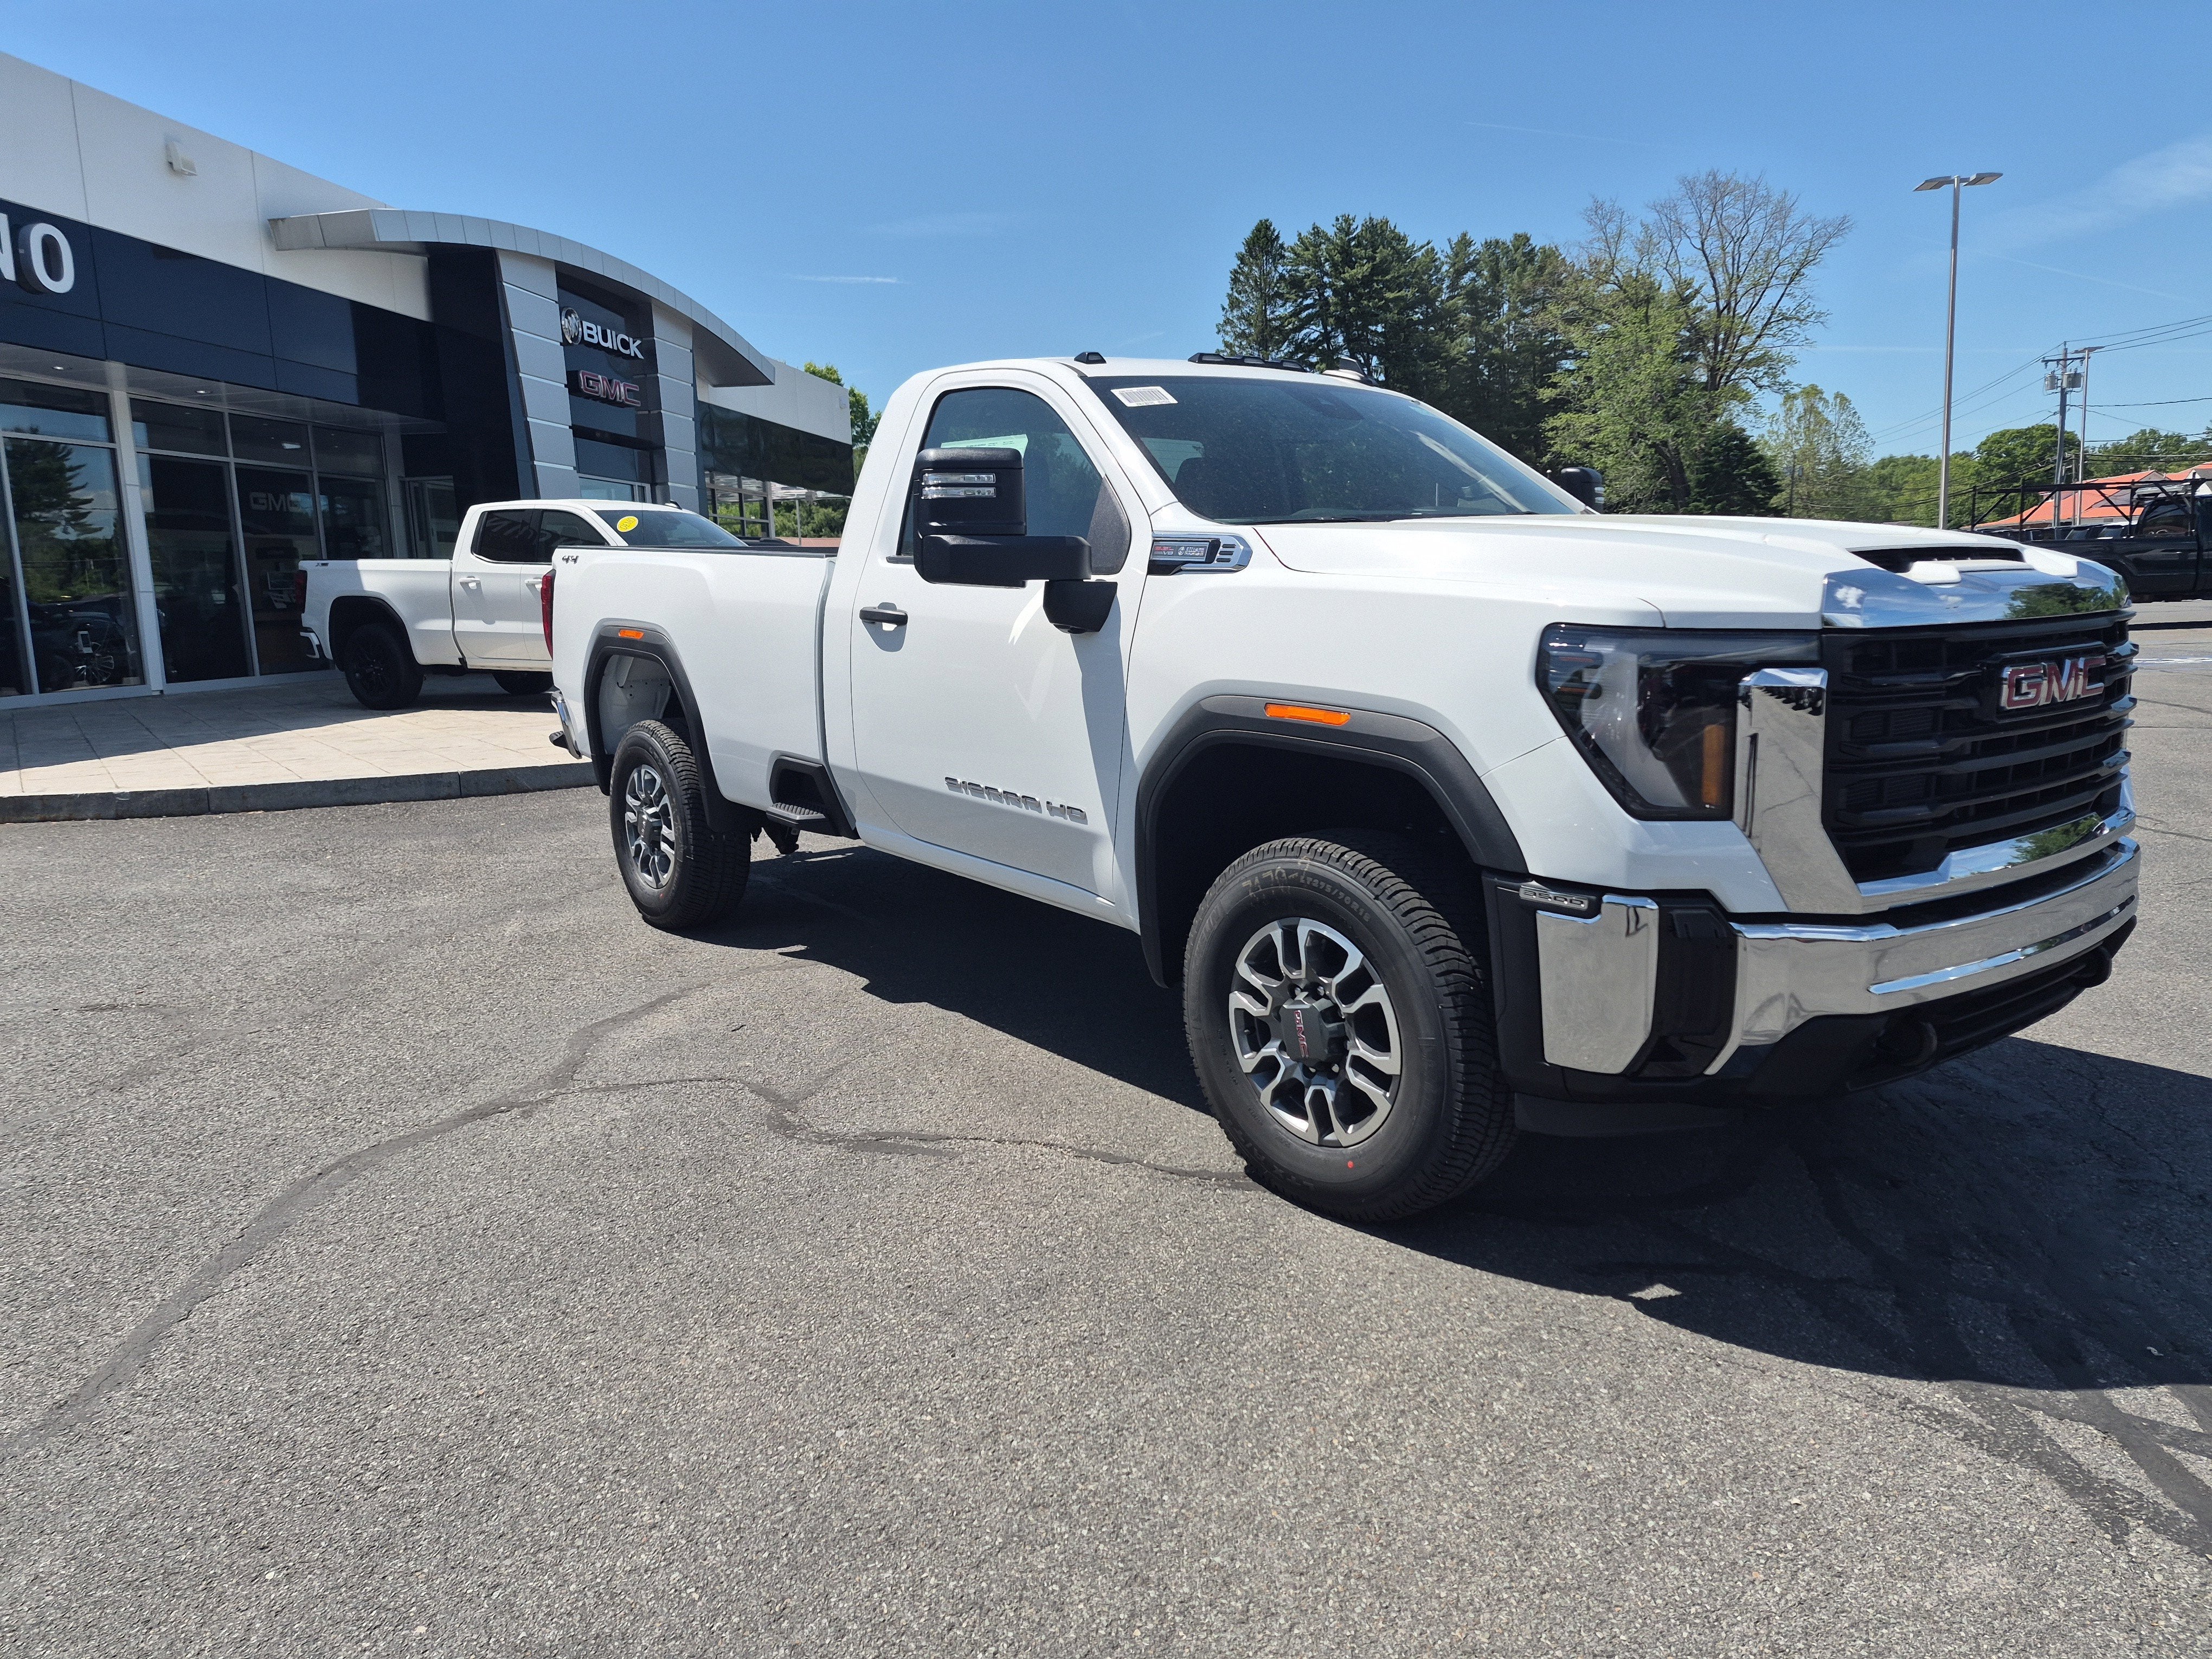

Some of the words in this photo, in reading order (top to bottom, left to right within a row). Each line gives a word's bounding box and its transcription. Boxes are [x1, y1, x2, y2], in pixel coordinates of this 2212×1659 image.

[582, 320, 644, 359] BUICK
[578, 370, 641, 407] GMC
[250, 492, 305, 512] GMC
[2001, 657, 2107, 710] GMC
[944, 777, 1042, 813] SIERRA
[1045, 801, 1088, 825] HD
[1523, 890, 1585, 908] 3500
[1294, 1009, 1309, 1058] GMC
